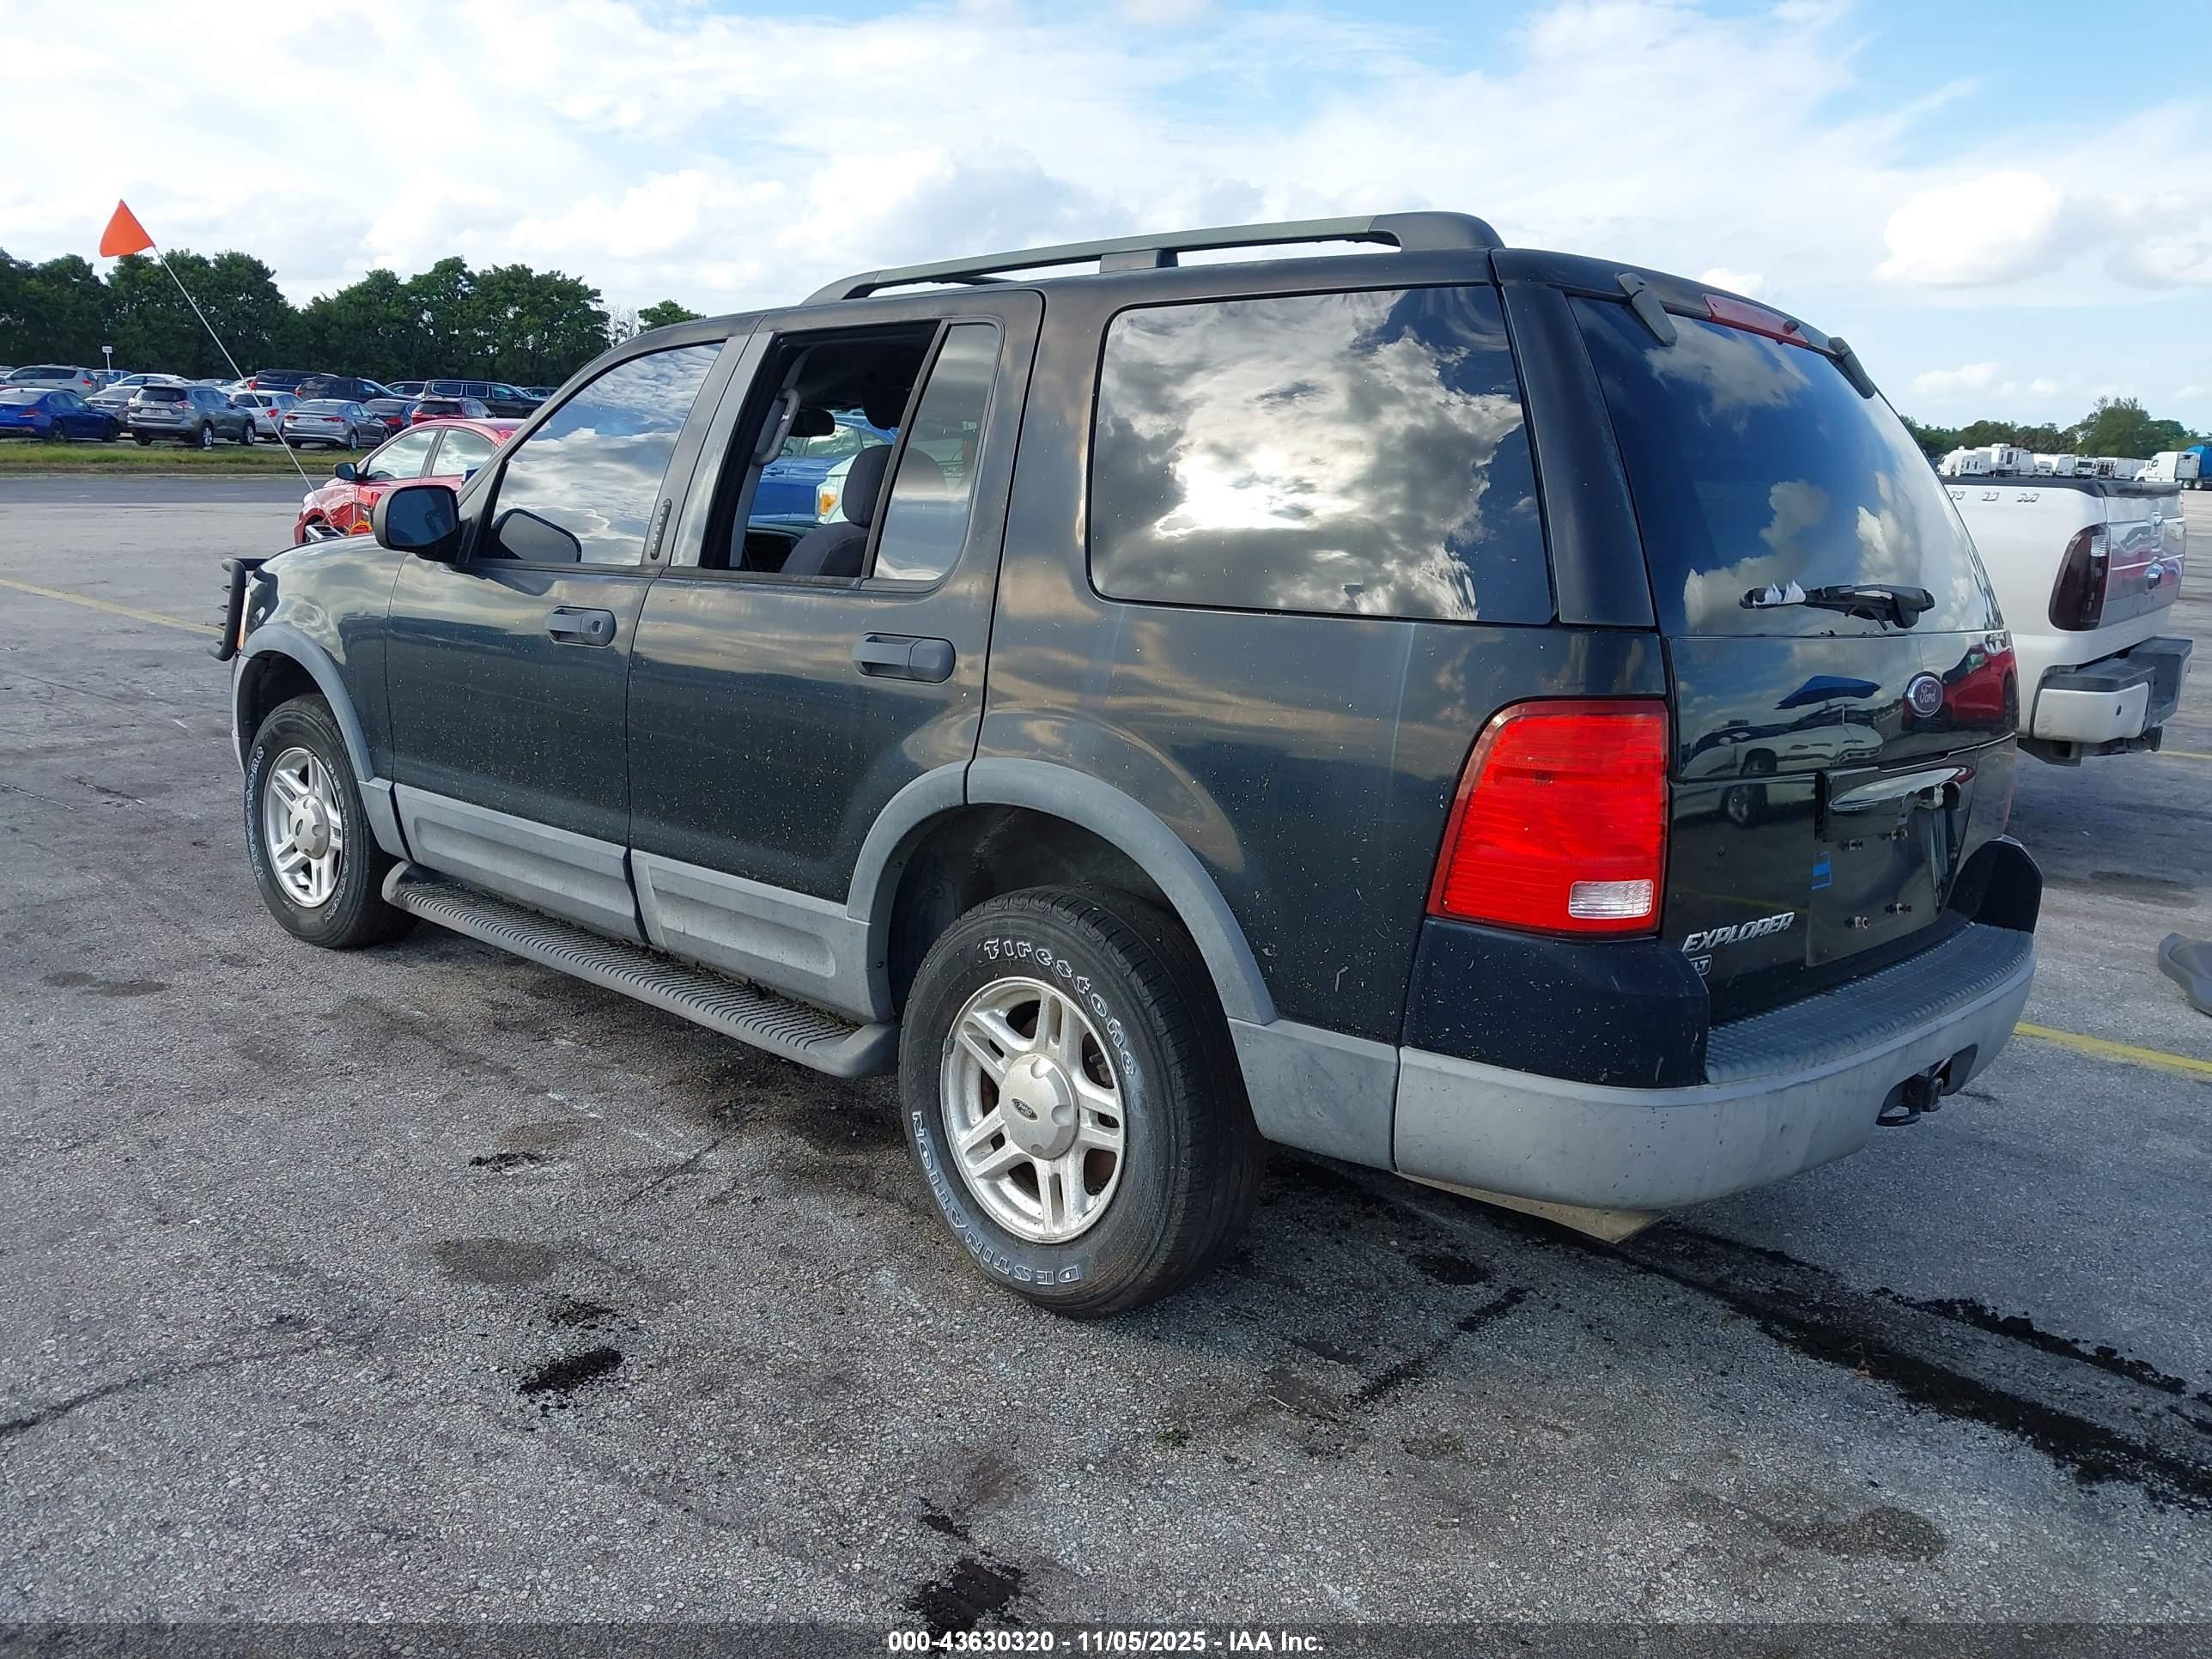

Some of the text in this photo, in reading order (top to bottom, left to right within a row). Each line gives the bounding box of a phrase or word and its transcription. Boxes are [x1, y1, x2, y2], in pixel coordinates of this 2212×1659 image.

[1919, 684, 1936, 704] Ford
[1681, 911, 1796, 953] EXPLORER
[1691, 959, 1709, 972] LT
[984, 938, 1135, 1075] Firestone
[912, 1110, 1082, 1285] DESTINATION
